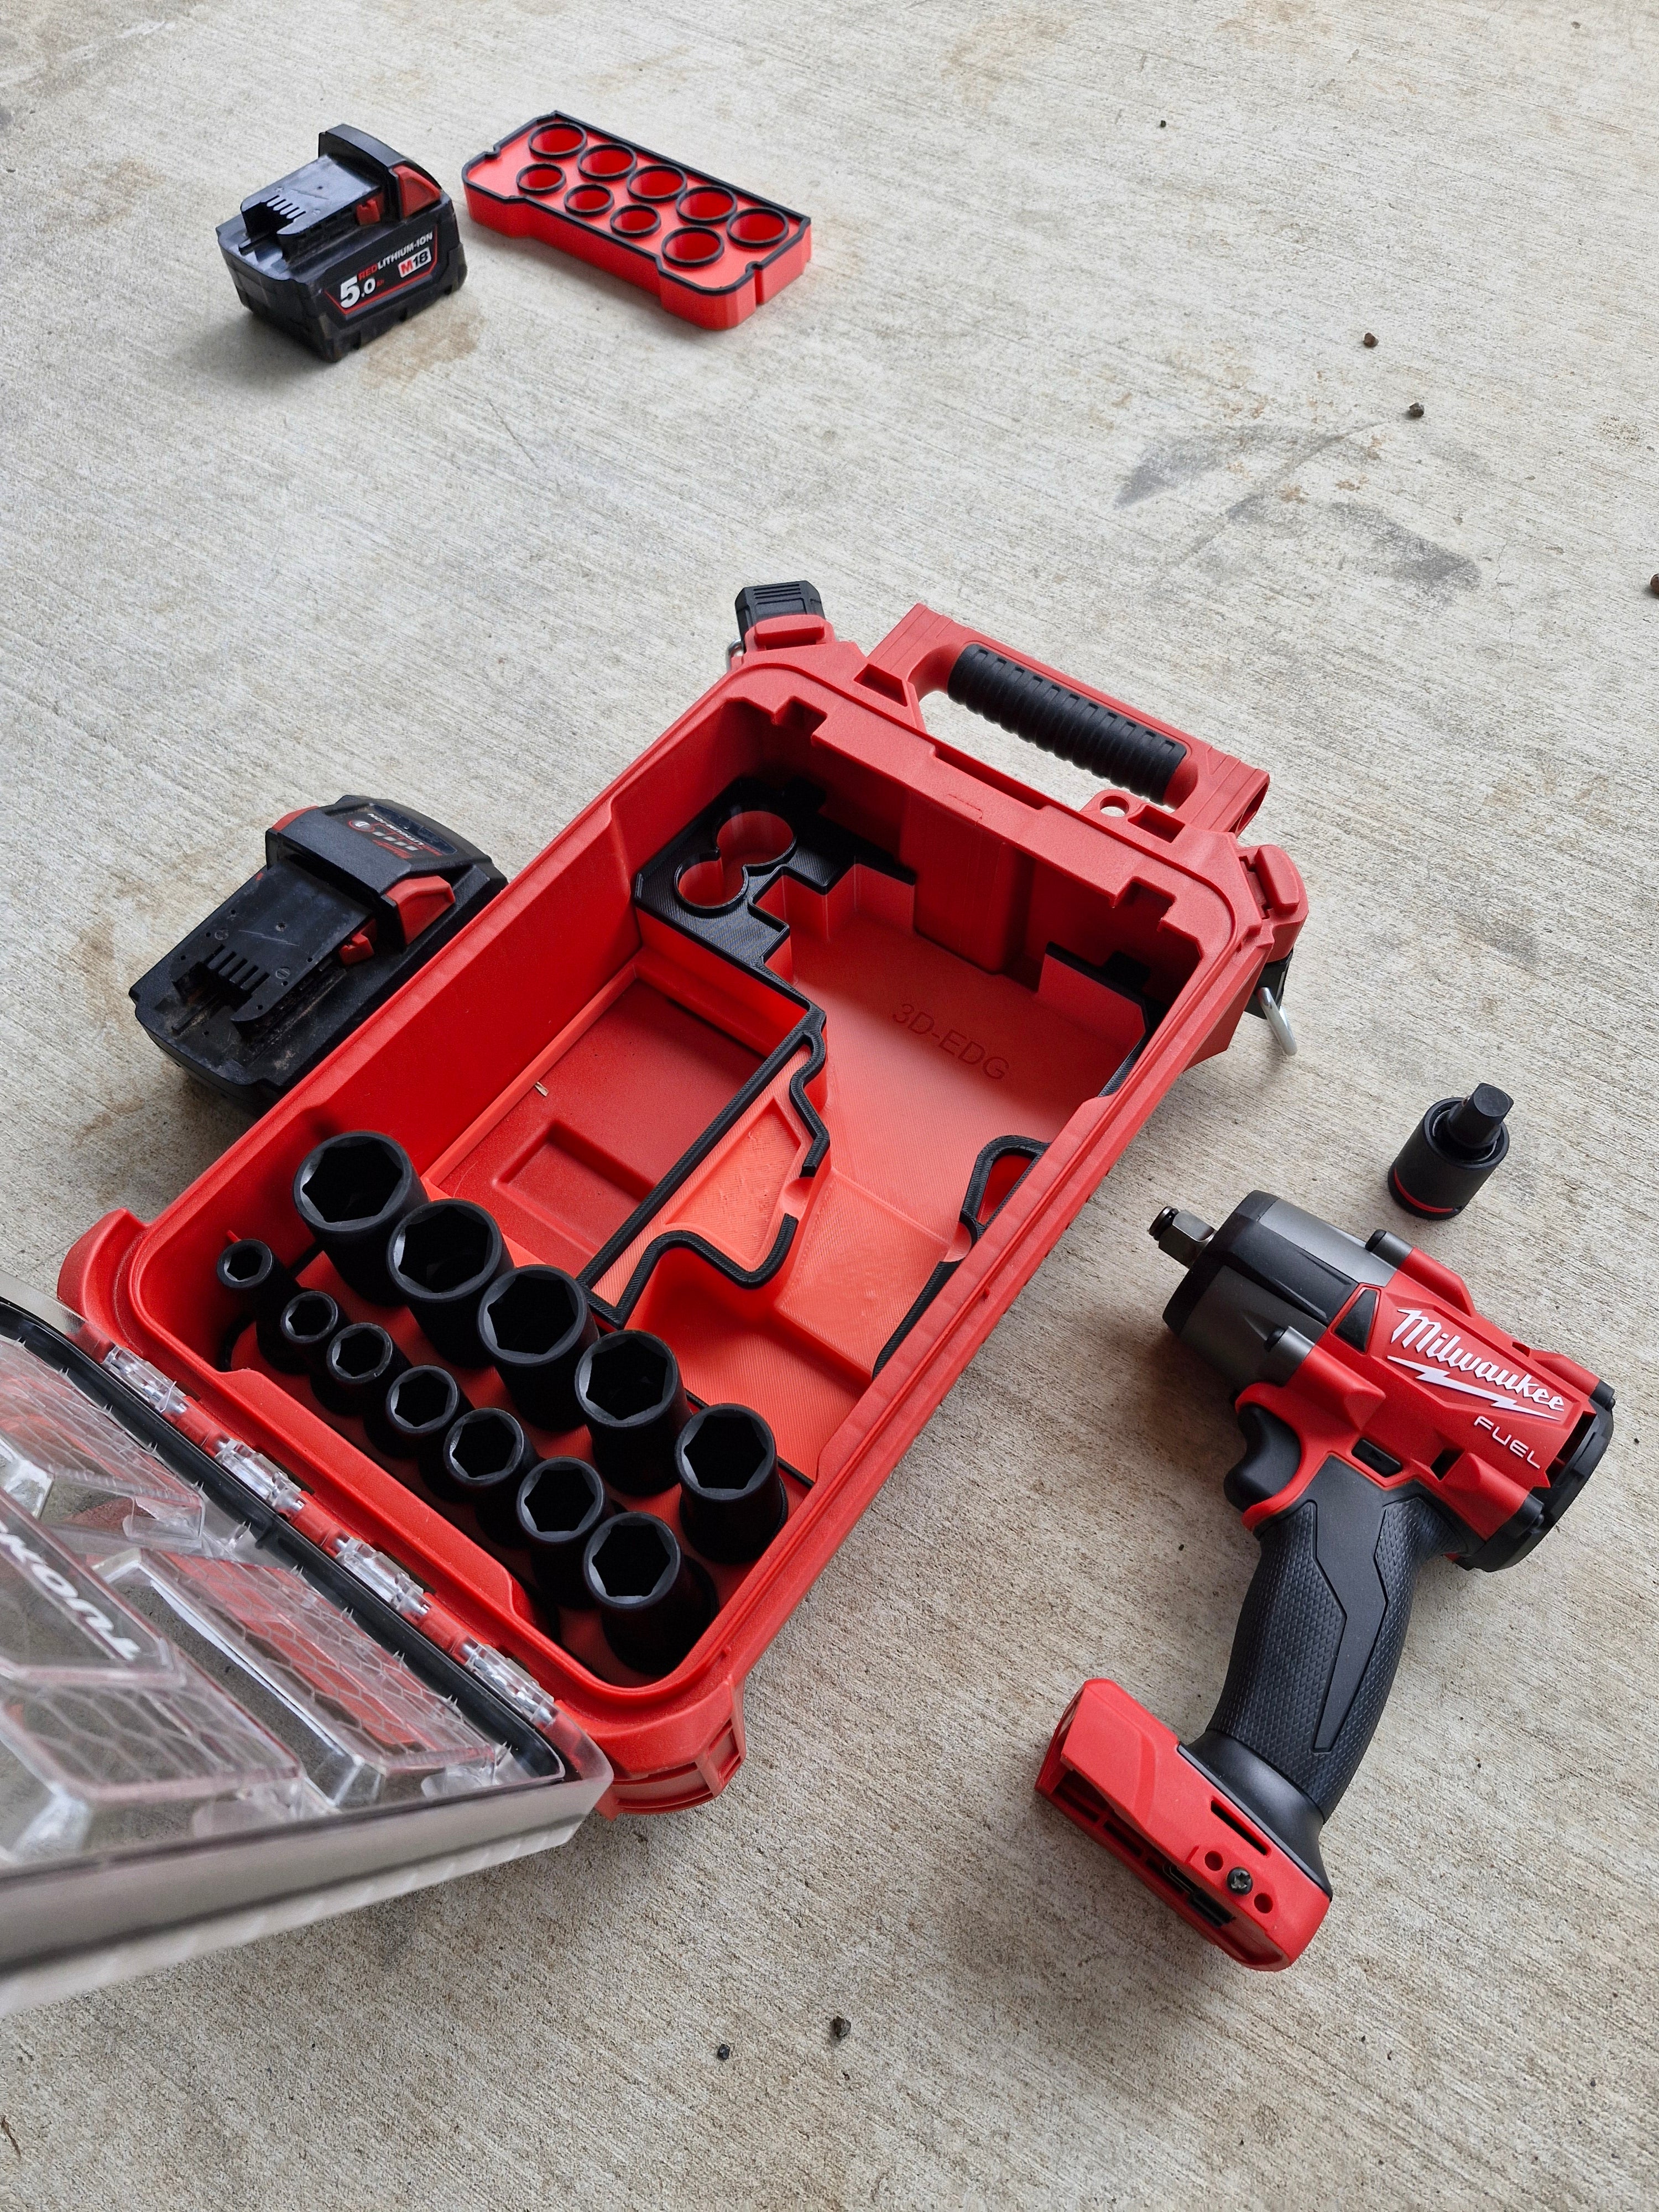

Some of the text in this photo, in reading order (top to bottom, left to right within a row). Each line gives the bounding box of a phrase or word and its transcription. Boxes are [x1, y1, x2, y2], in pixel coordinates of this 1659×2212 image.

[358, 231, 433, 281] REDLITHIUM-ION
[400, 251, 429, 275] M18
[340, 275, 376, 308] 5.0
[892, 1003, 1010, 1080] 3D-EDG
[1390, 1308, 1565, 1412] Milwaukee
[1473, 1415, 1541, 1469] FUEL
